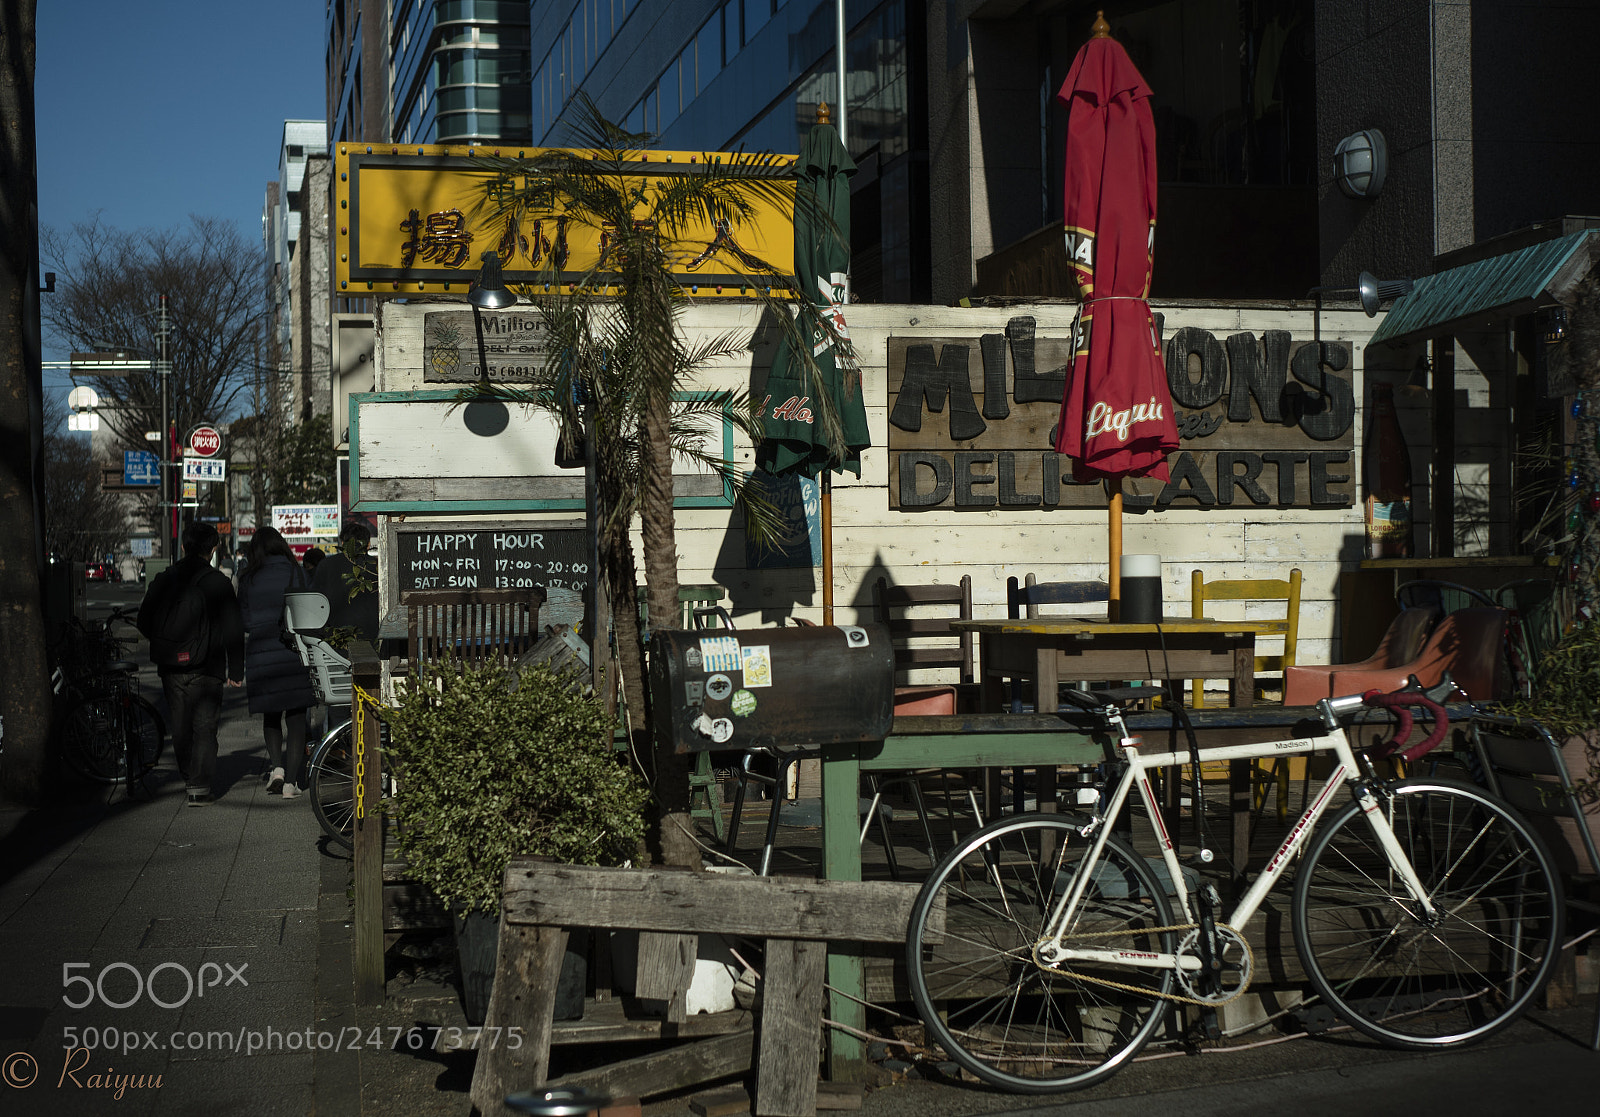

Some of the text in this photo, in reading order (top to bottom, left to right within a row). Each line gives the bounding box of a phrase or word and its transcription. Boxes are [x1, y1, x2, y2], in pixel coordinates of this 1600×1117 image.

[480, 316, 551, 334] Million
[481, 344, 548, 353] DELI-CAR
[888, 315, 1357, 441] MILONS
[773, 395, 814, 424] Alo
[417, 533, 545, 553] HAPPY HOUR
[1275, 740, 1309, 750] Madison
